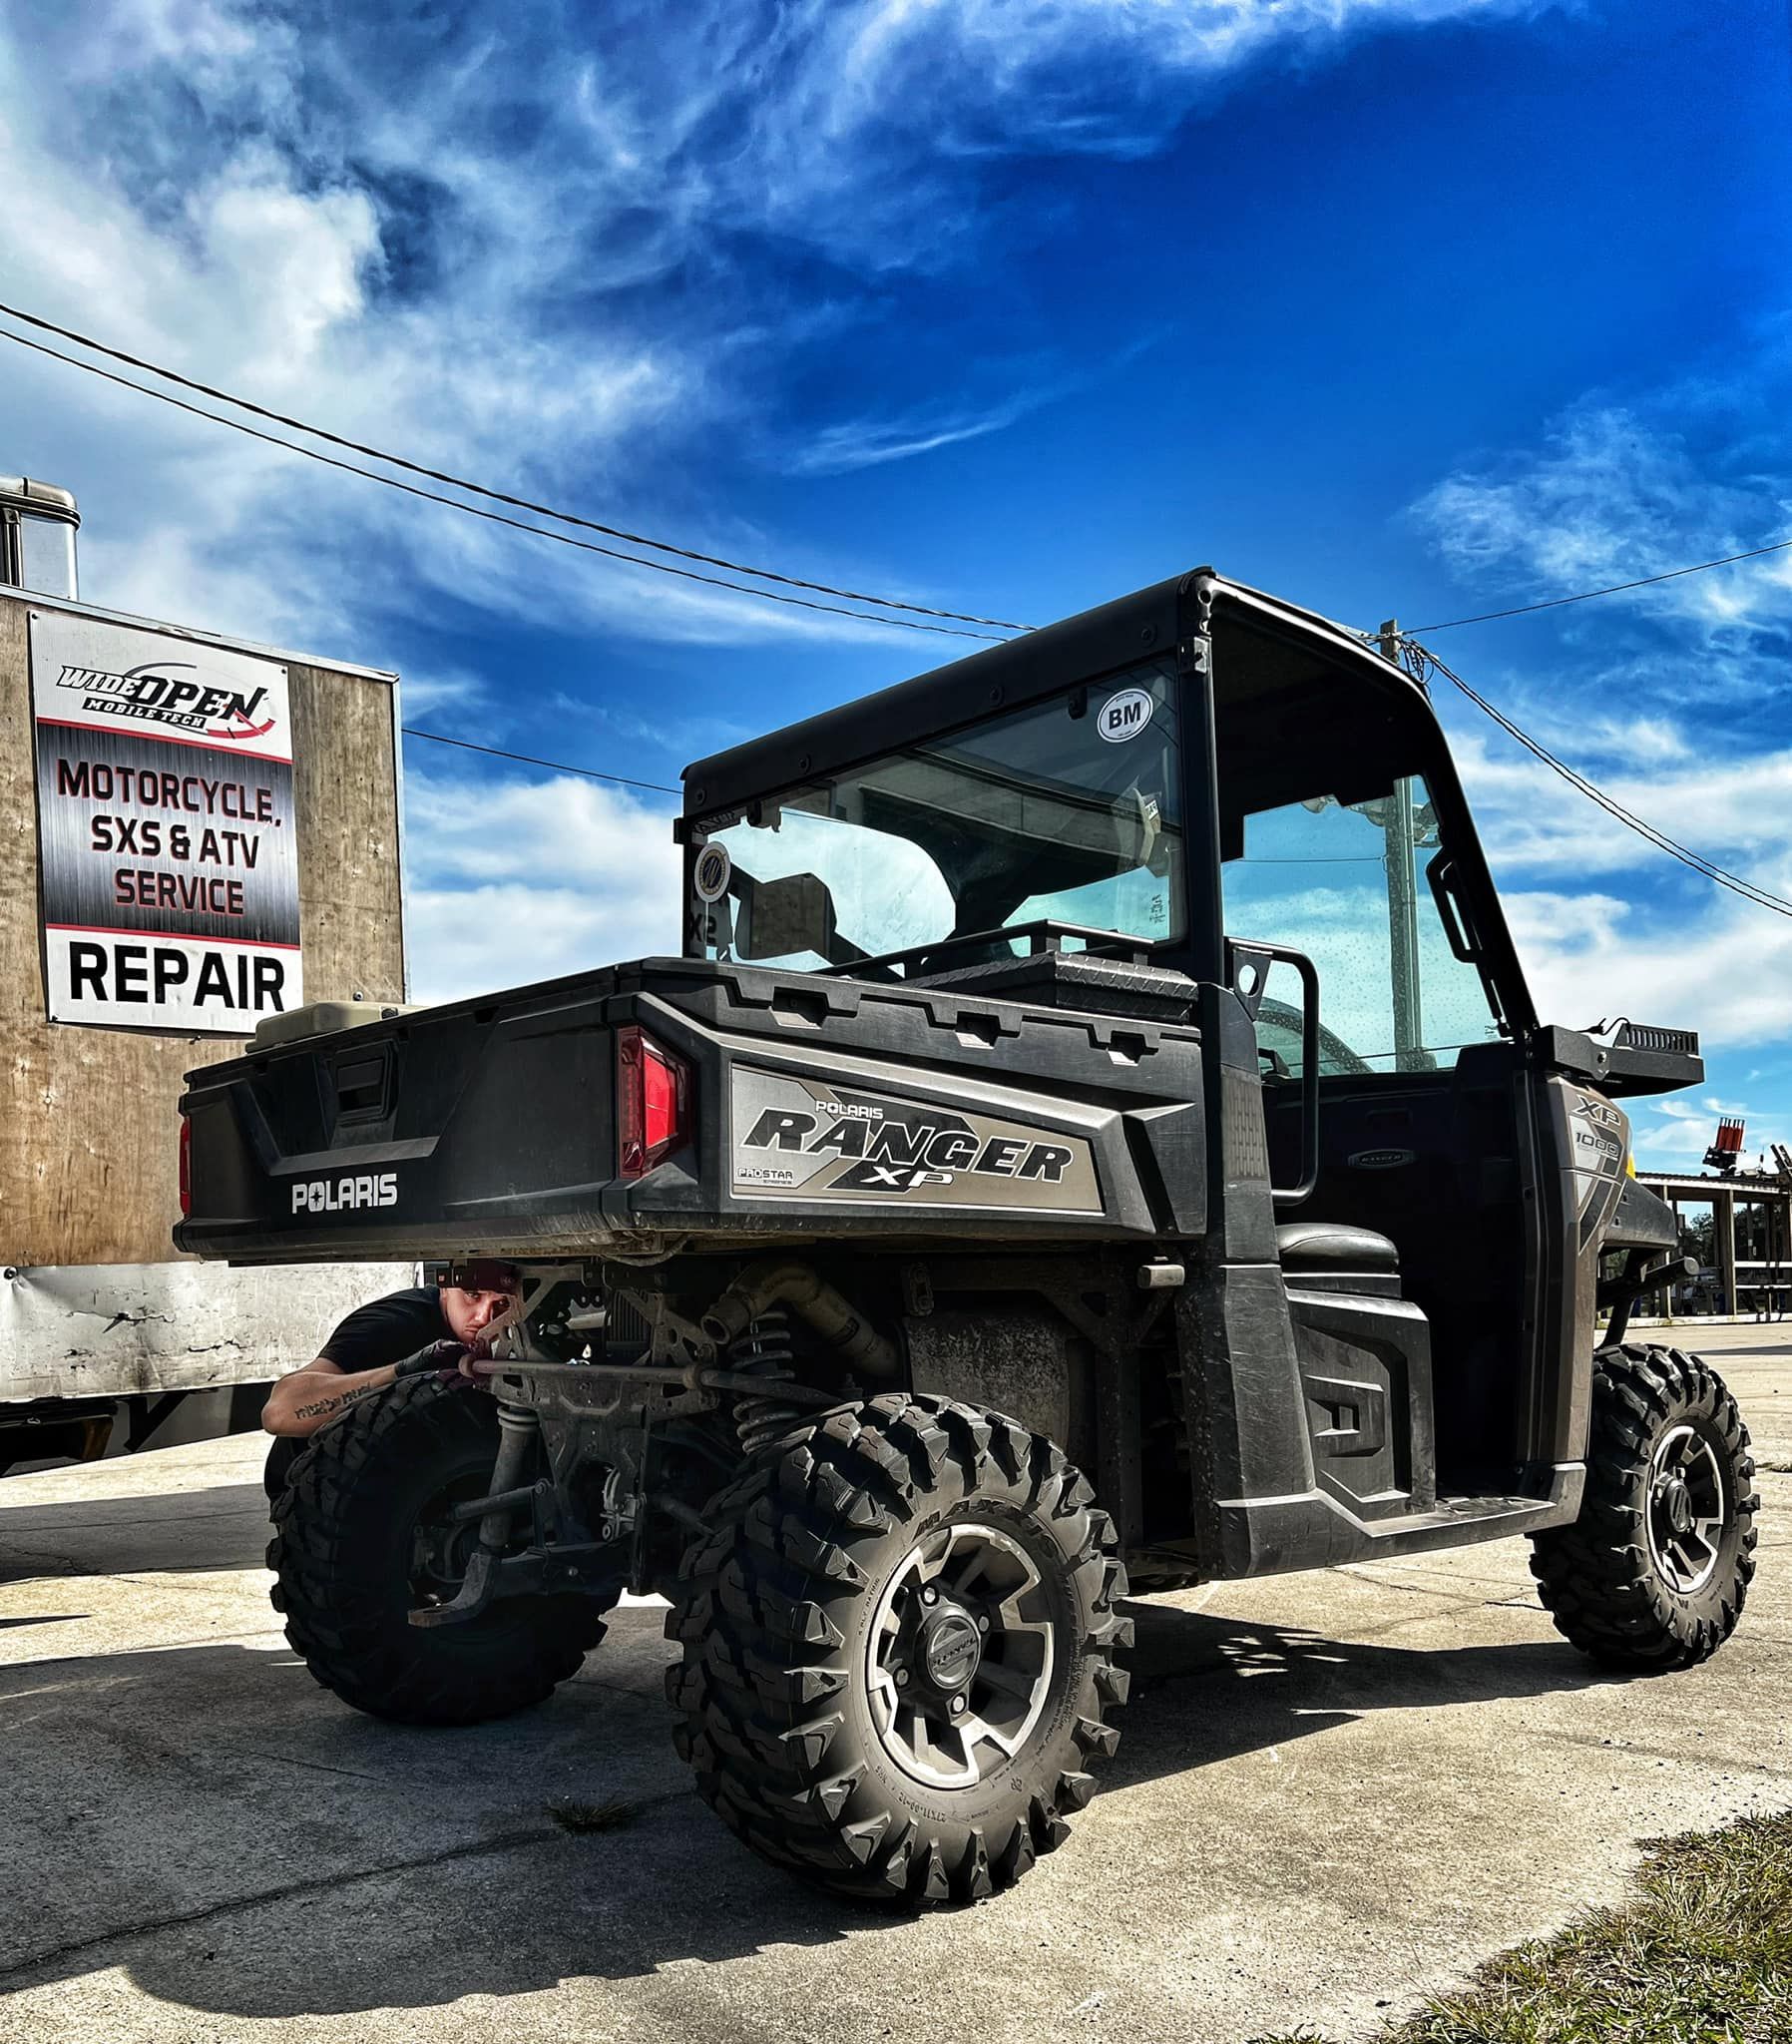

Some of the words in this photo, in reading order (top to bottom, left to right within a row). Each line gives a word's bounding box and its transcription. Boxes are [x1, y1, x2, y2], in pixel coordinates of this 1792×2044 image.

[56, 666, 143, 698] WIDE
[125, 676, 267, 723] OPEN
[87, 700, 156, 719] MOBILE
[161, 712, 204, 728] TECH
[1109, 702, 1140, 730] BM
[57, 759, 281, 826] MOTORCYCLE,
[91, 814, 160, 856] SXS
[170, 824, 191, 860] &
[199, 829, 259, 869] ATV
[115, 868, 244, 915] SERVICE
[69, 940, 285, 1012] REPAIR
[815, 1100, 883, 1120] POLARIS
[1572, 1094, 1620, 1126] XP
[740, 1107, 1074, 1184] RANGER
[291, 1173, 398, 1214] POLARIS
[738, 1167, 793, 1180] PROSTAR
[860, 1166, 955, 1189] XP
